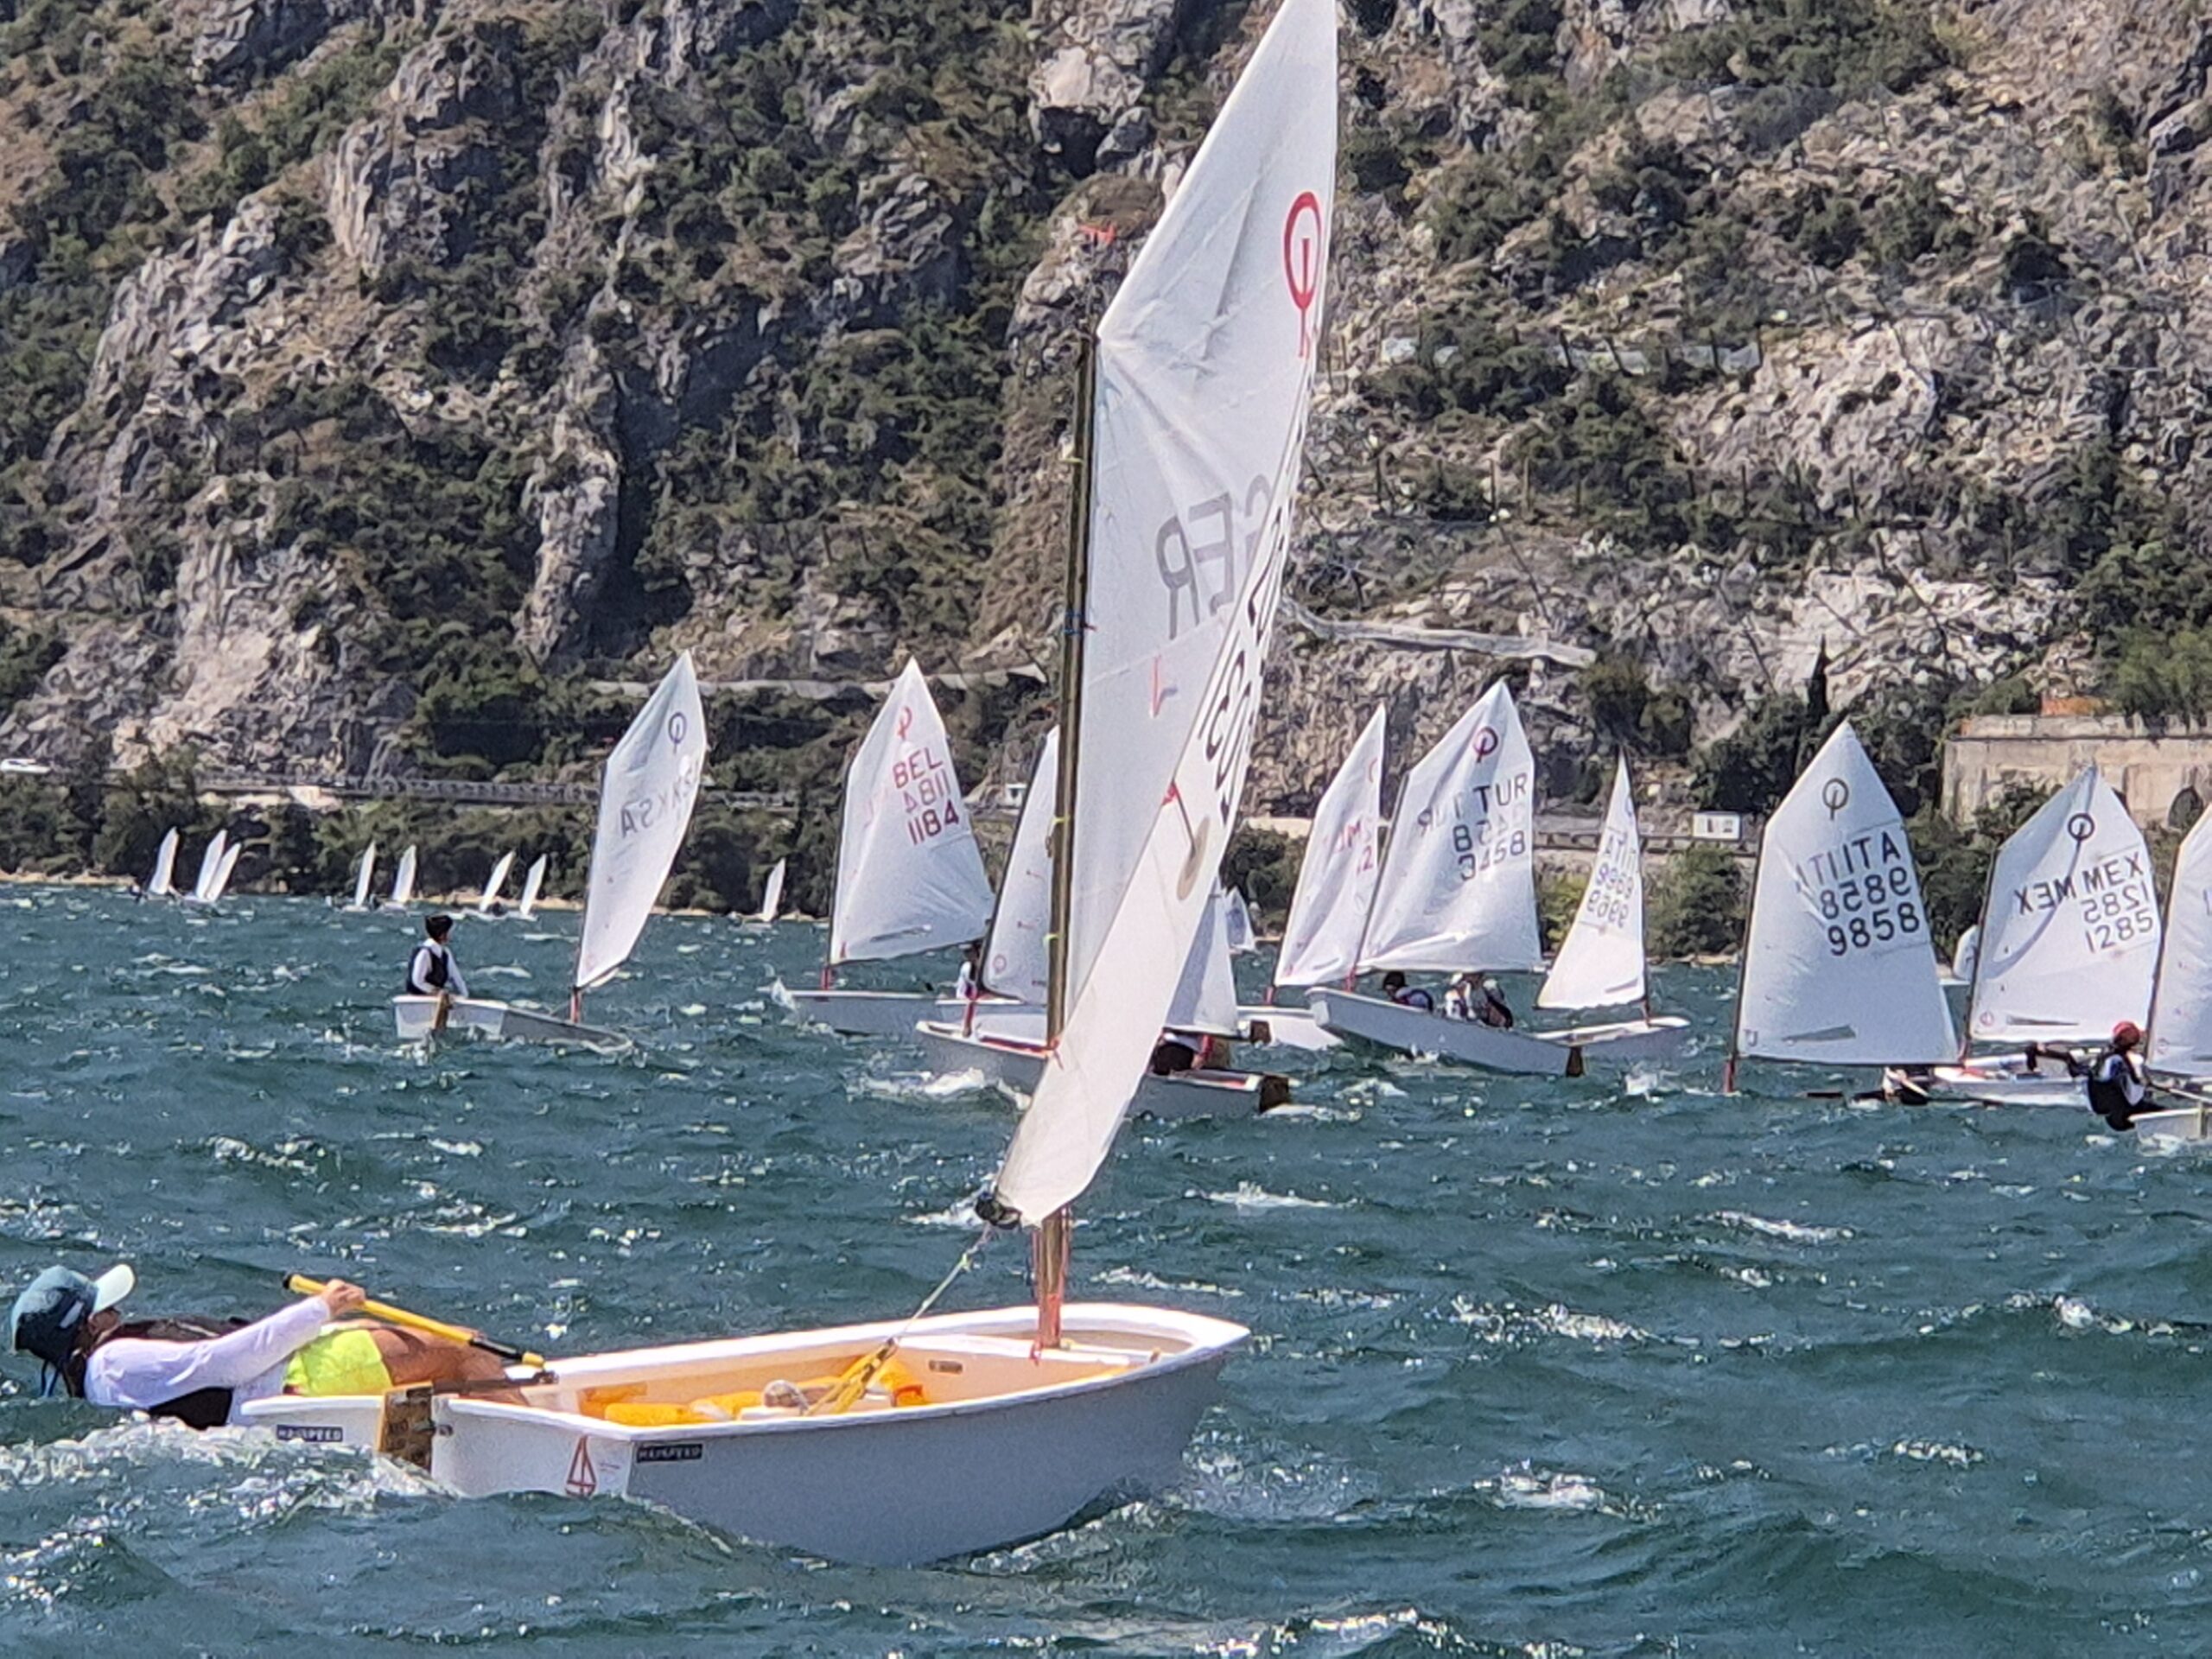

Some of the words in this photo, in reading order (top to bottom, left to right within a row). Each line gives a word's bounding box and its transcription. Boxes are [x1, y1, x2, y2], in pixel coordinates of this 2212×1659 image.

[892, 747, 944, 789] BEL
[1472, 772, 1528, 814] TUR
[908, 799, 960, 844] 1184
[1843, 831, 1901, 874] ITA
[2082, 851, 2145, 894] MEX
[1827, 901, 1920, 957] 9858
[2085, 908, 2154, 953] 1285
